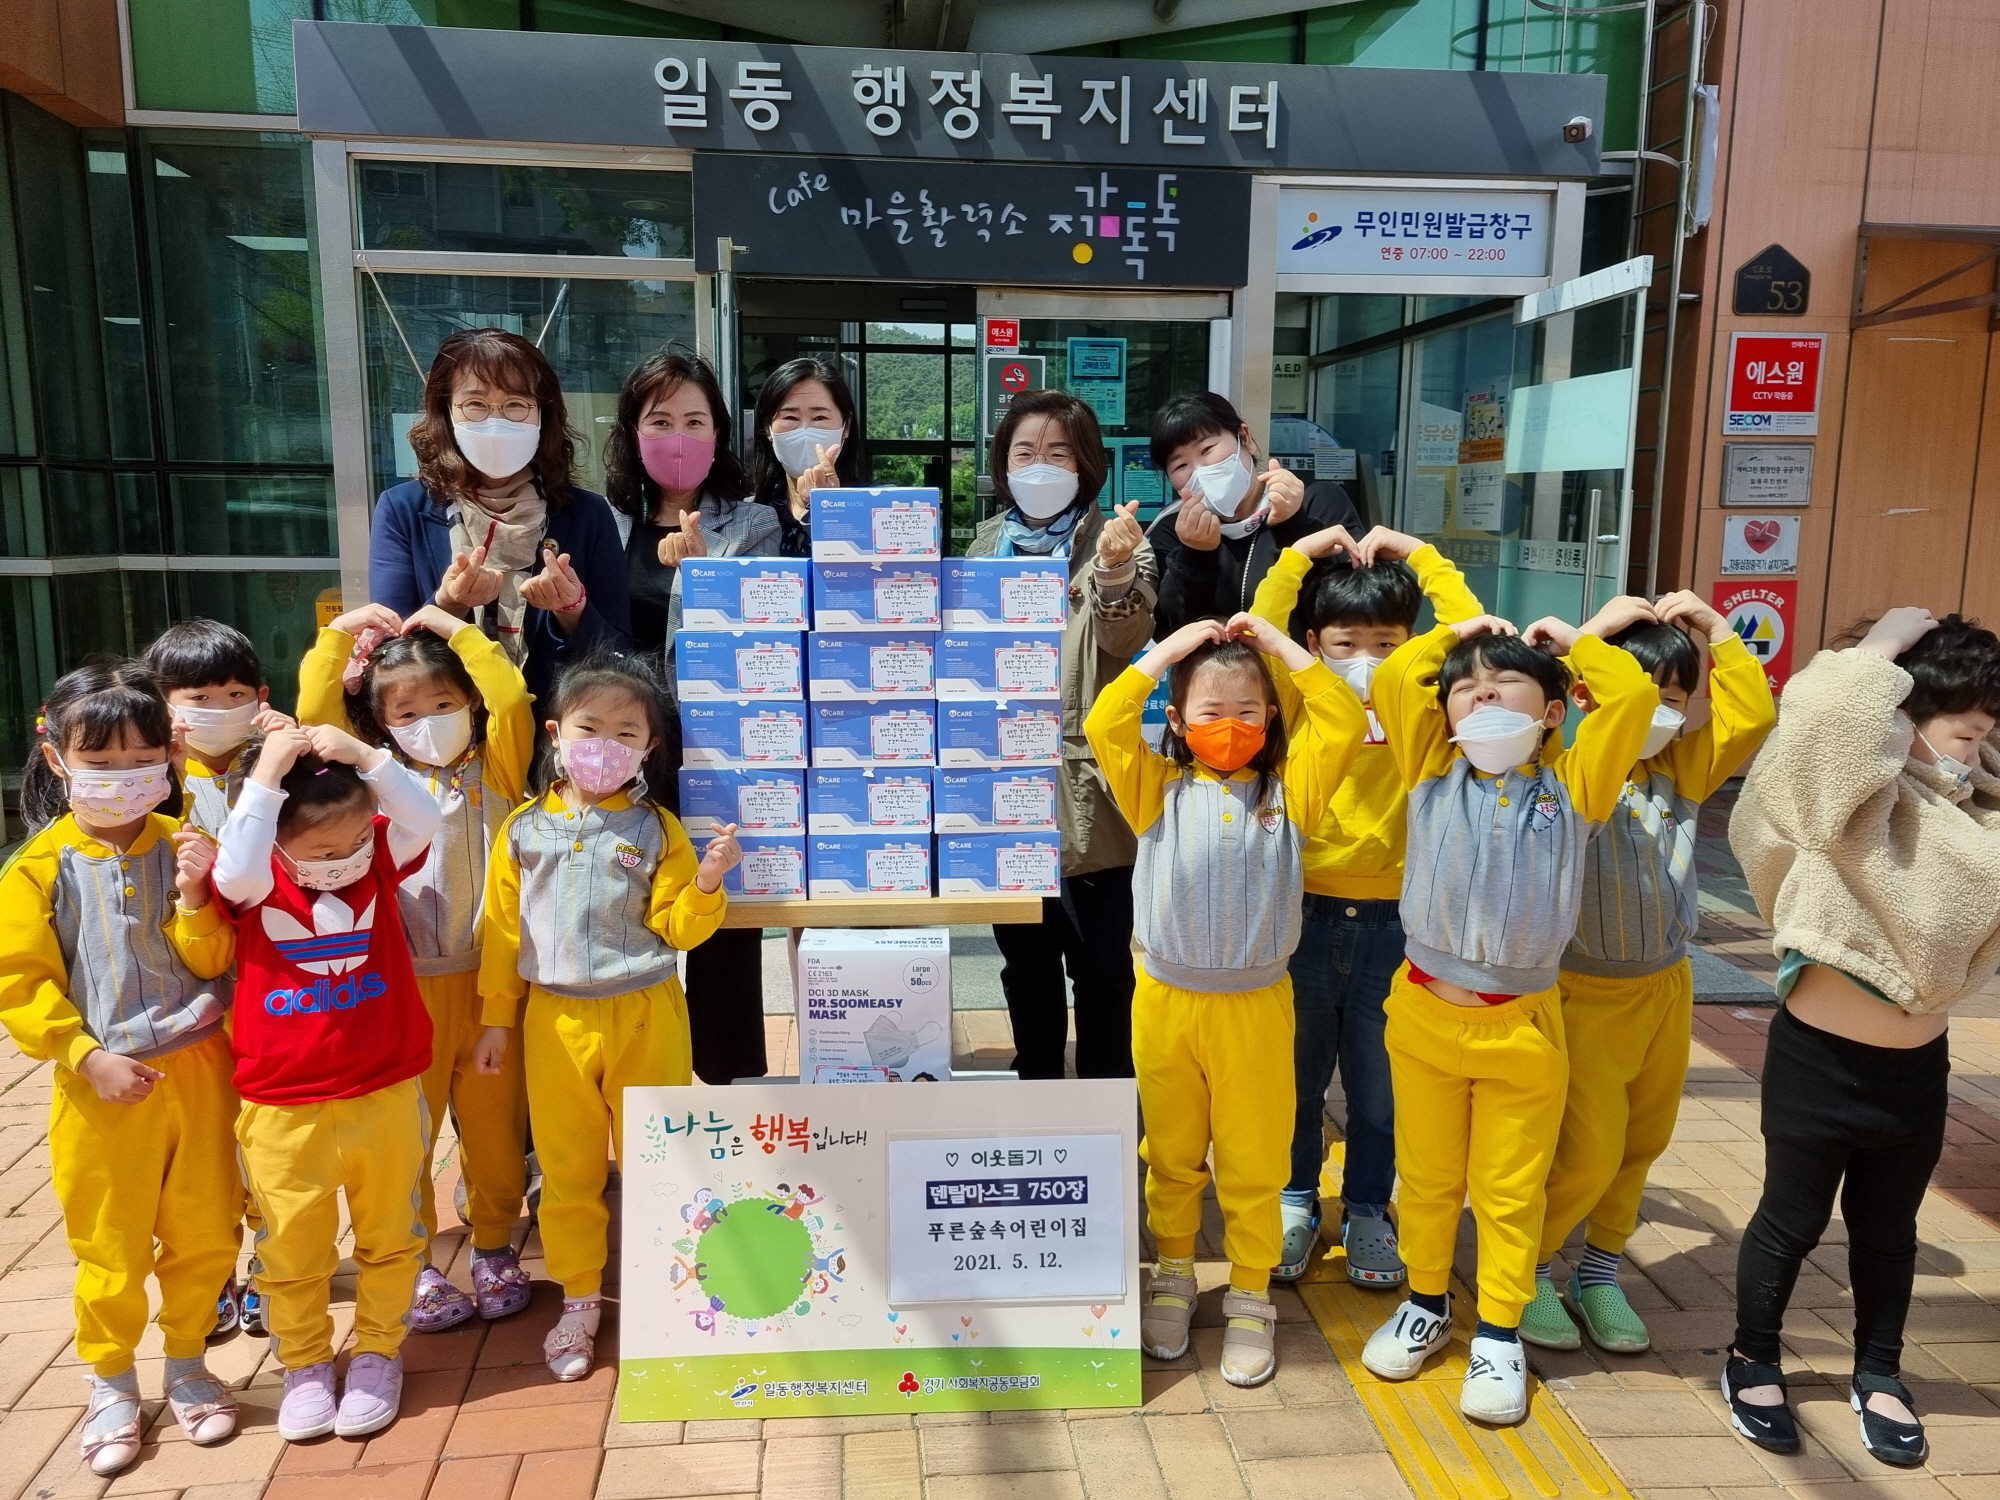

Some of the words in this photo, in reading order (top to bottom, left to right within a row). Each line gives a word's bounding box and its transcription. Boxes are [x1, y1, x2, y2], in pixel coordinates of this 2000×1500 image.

[654, 57, 791, 131] 일동
[852, 63, 1277, 149] 행정복지센터
[769, 171, 830, 214] Cafe
[841, 189, 1028, 248] 마을활력소
[1354, 211, 1533, 240] 무인민원발급창구
[1380, 247, 1404, 261] 연중
[1410, 248, 1448, 260] 07:00
[1468, 248, 1506, 261] 22:00
[1767, 281, 1803, 310] 53
[991, 328, 1013, 338] 에스원
[1274, 364, 1301, 372] AED
[1746, 360, 1805, 385] 에스원
[1752, 391, 1773, 400] CCTV
[1729, 414, 1772, 426] SECOM
[1723, 588, 1785, 610] SHELTER
[1540, 803, 1557, 813] HS
[1263, 816, 1277, 826] HS
[621, 853, 636, 866] HS
[912, 965, 931, 973] Large
[910, 977, 932, 986] 50pcs
[808, 999, 903, 1009] DR.SOOMEASY
[809, 1010, 847, 1020] MASK
[664, 1110, 744, 1159] 나눔은
[749, 1112, 868, 1155] 행복입니다!
[971, 1149, 1042, 1168] 이웃돕기
[929, 1183, 1021, 1205] 덴탈마스크
[1028, 1180, 1086, 1201] 750장
[927, 1217, 1087, 1243] 푸른숲속어린이집
[954, 1254, 1001, 1271] 2021.
[1012, 1253, 1028, 1270] 5.
[1039, 1252, 1063, 1269] 12.
[1240, 1304, 1261, 1312] adidas
[763, 1379, 867, 1397] 일동행정복지센터
[923, 1377, 945, 1394] 경기
[947, 1375, 1040, 1392] 사회복지공동모금회
